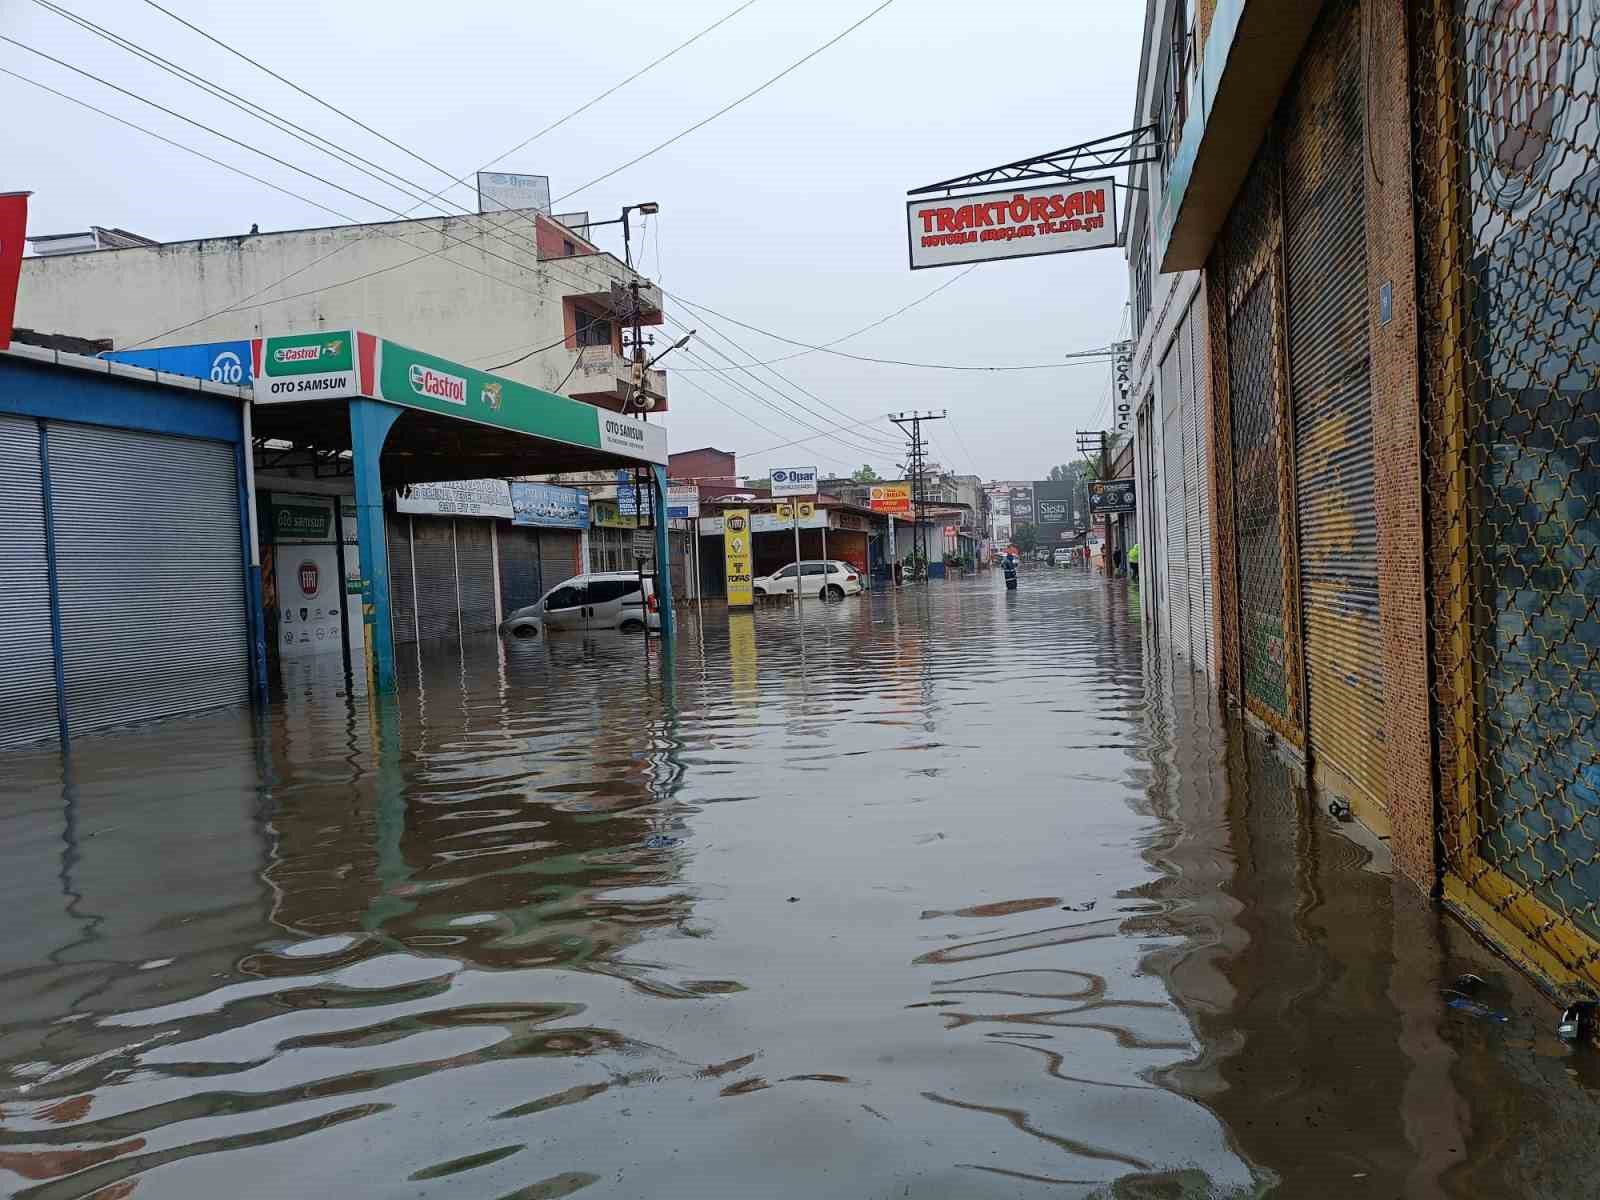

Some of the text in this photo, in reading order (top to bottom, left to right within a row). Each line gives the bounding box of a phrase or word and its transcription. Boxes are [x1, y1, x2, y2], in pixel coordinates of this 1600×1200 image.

[286, 347, 317, 360] Castrol
[211, 360, 242, 383] oto
[271, 377, 346, 394] OTO SAMSUN
[424, 371, 464, 401] Castrol
[605, 420, 644, 442] OTO SAMSUN
[789, 471, 814, 483] Opar
[302, 571, 316, 588] FIAT
